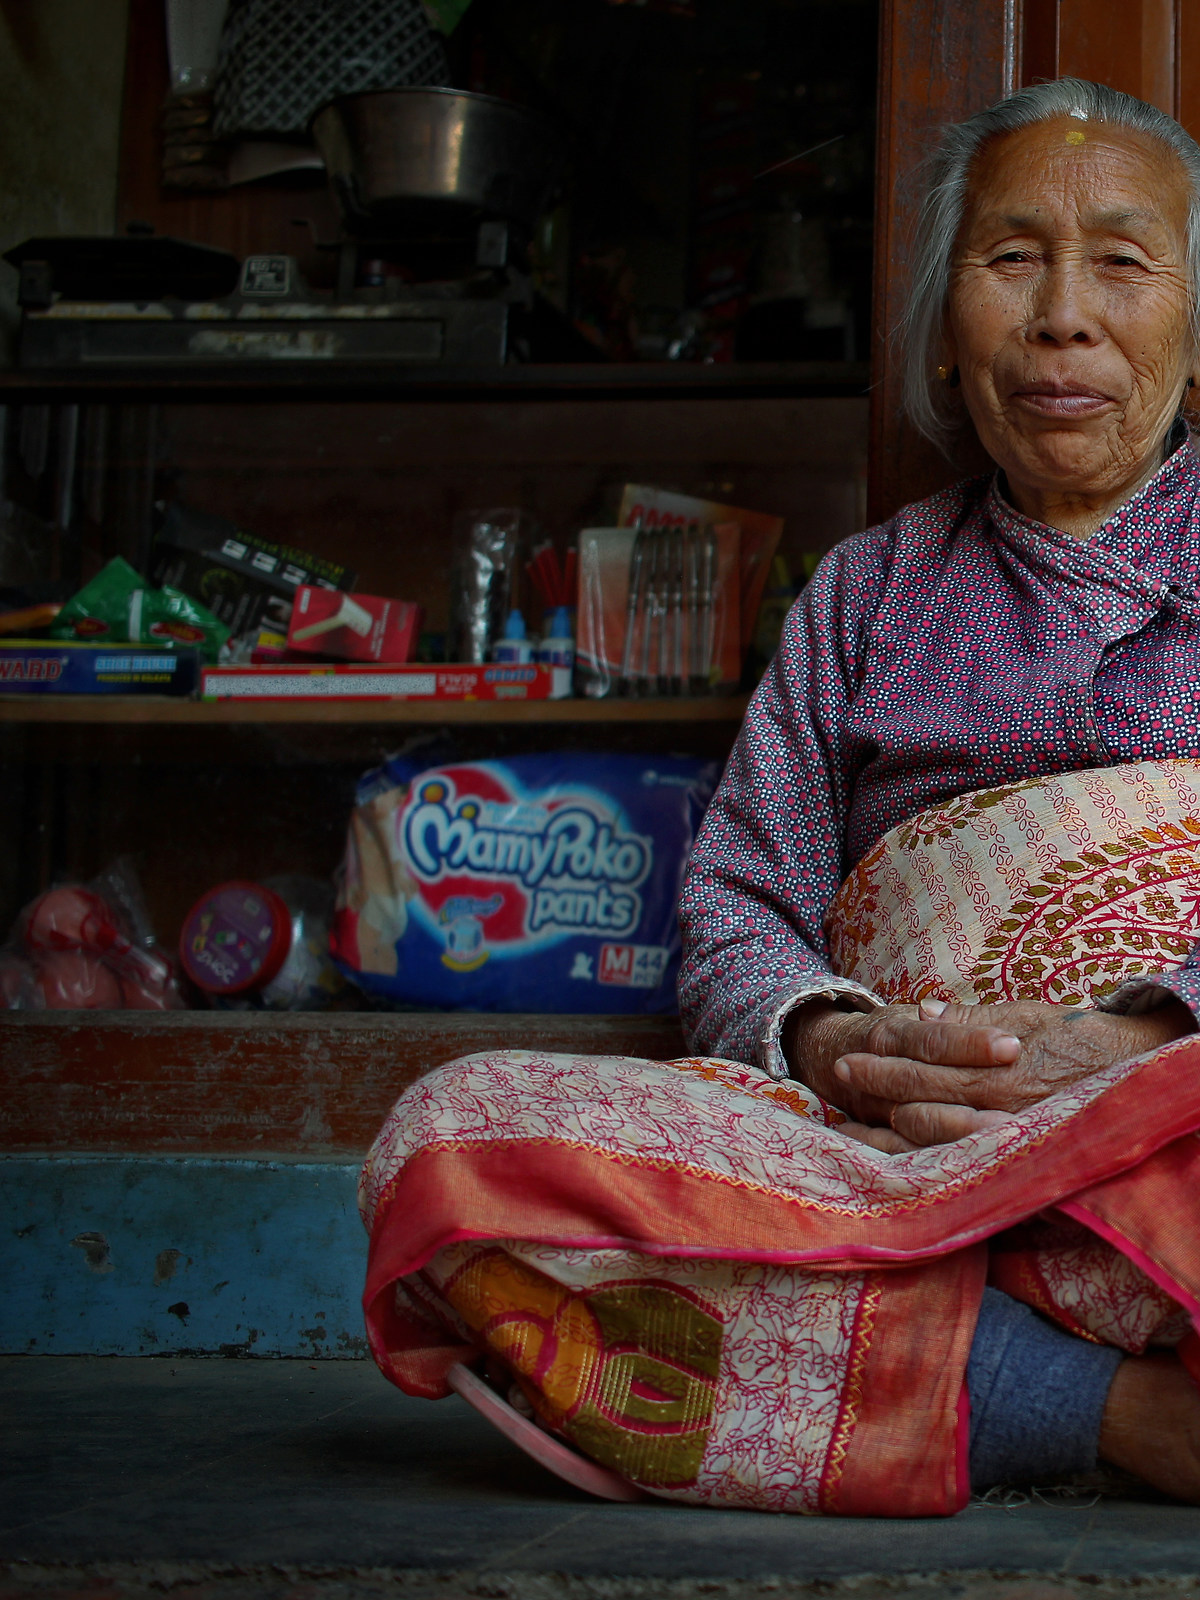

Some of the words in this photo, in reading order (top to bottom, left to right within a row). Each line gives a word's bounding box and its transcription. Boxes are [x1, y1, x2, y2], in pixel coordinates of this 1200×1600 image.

[404, 780, 646, 887] MamyPoko
[529, 887, 634, 932] pants
[605, 948, 630, 971] M
[636, 951, 662, 970] 44
